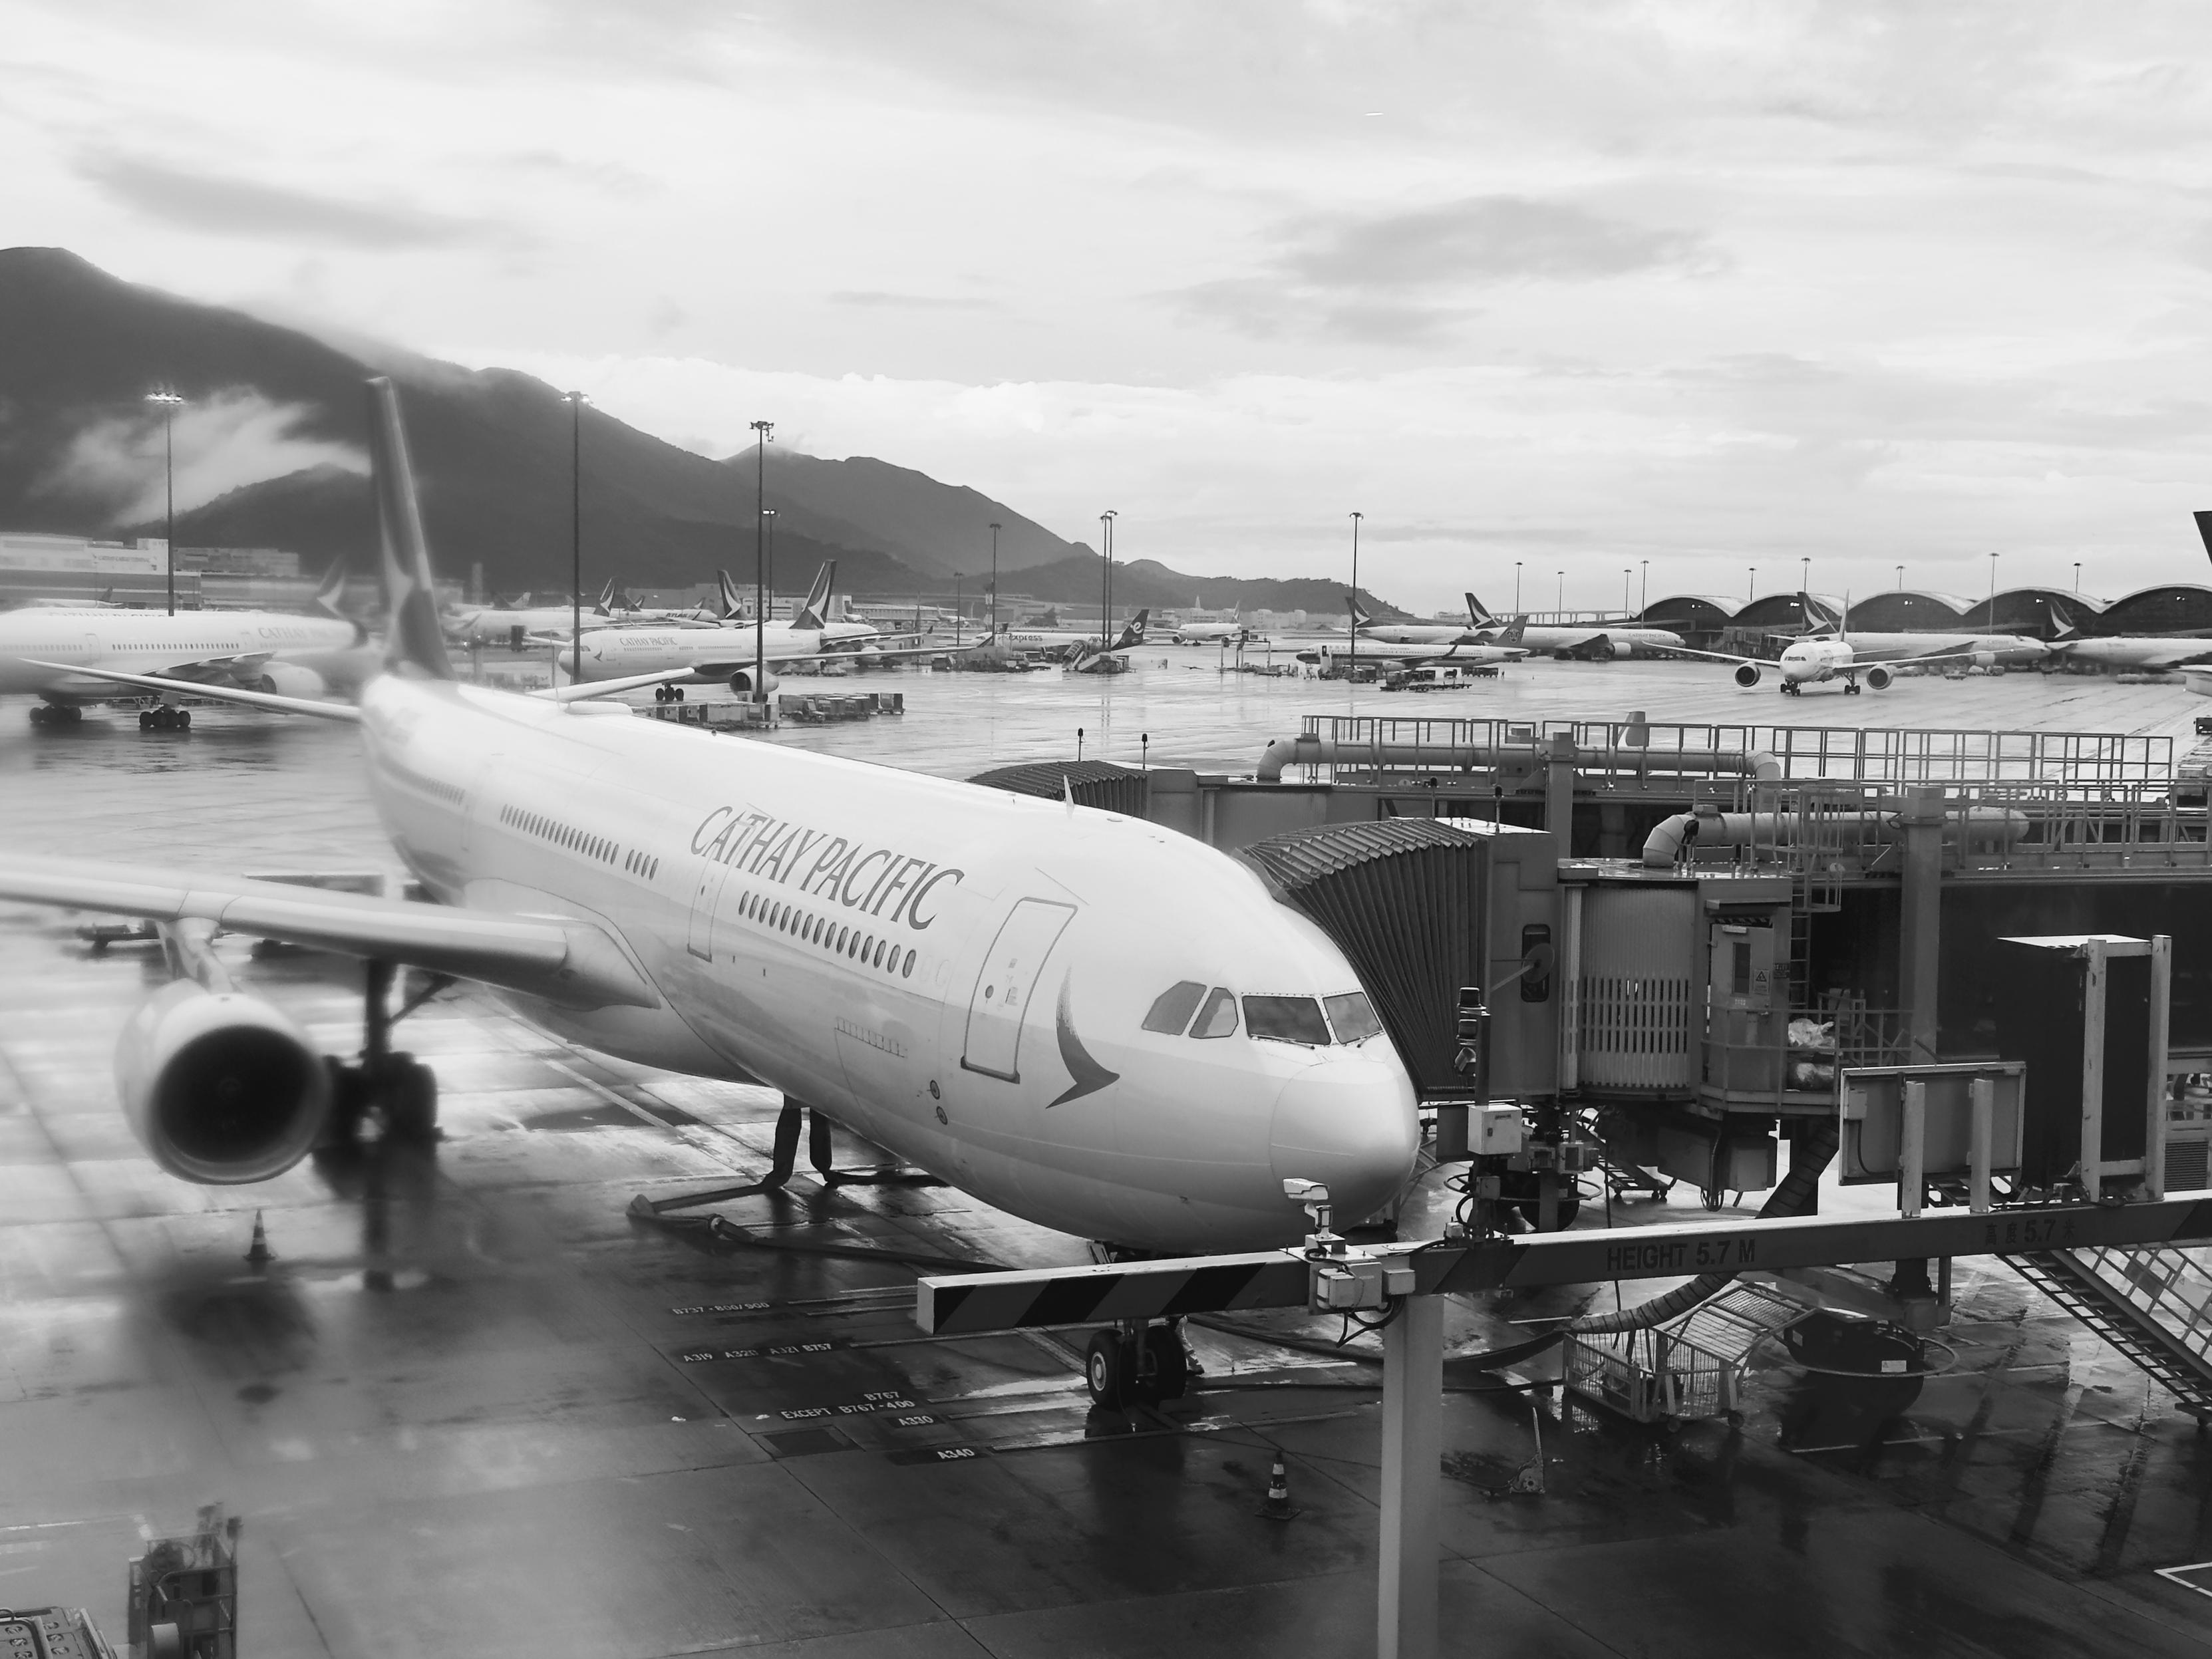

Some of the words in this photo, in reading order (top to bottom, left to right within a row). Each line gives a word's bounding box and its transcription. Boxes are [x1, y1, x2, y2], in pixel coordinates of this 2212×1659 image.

[619, 637, 649, 647] CATHAY
[649, 637, 679, 646] PACIFIC
[691, 806, 829, 884] CATHAY
[800, 837, 965, 931] PACIFIC
[2024, 1219, 2056, 1243] 5.7
[2064, 1219, 2076, 1240] 米
[1607, 1242, 1688, 1271] HEIGHT
[1696, 1240, 1731, 1266] 5.7
[1738, 1238, 1756, 1263] M
[683, 1353, 714, 1362] A319
[724, 1350, 759, 1359] A320
[770, 1346, 800, 1354] A321
[802, 1343, 832, 1352] B757
[864, 1391, 900, 1402] B767
[781, 1406, 832, 1420] EXCEPT
[898, 1415, 934, 1426] A330
[937, 1448, 975, 1460] A340
